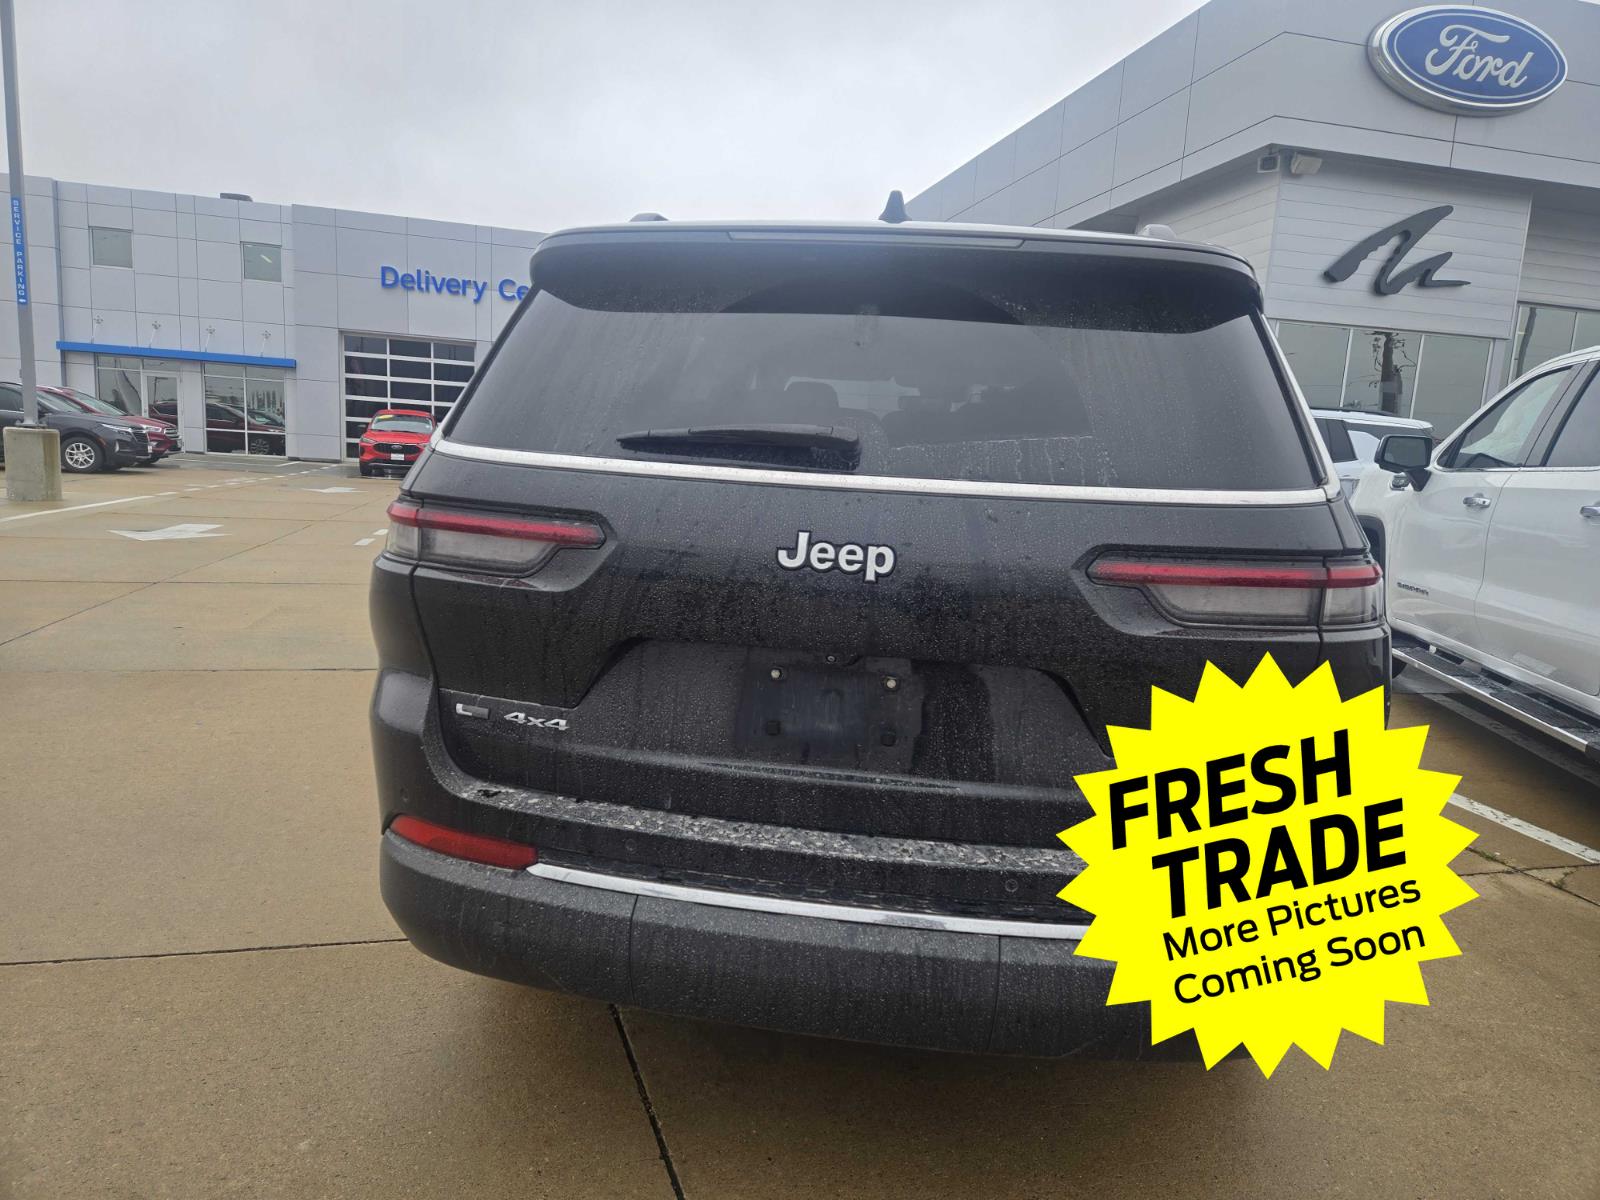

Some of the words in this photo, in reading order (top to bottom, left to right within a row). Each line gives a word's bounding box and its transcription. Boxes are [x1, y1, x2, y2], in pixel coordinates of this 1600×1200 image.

[1424, 24, 1535, 88] Ford
[13, 199, 21, 245] SERVICE
[16, 251, 25, 296] PARKING
[380, 265, 488, 304] Delivery
[498, 278, 529, 301] Ce
[777, 531, 895, 582] Jeep
[504, 711, 570, 731] 4x4
